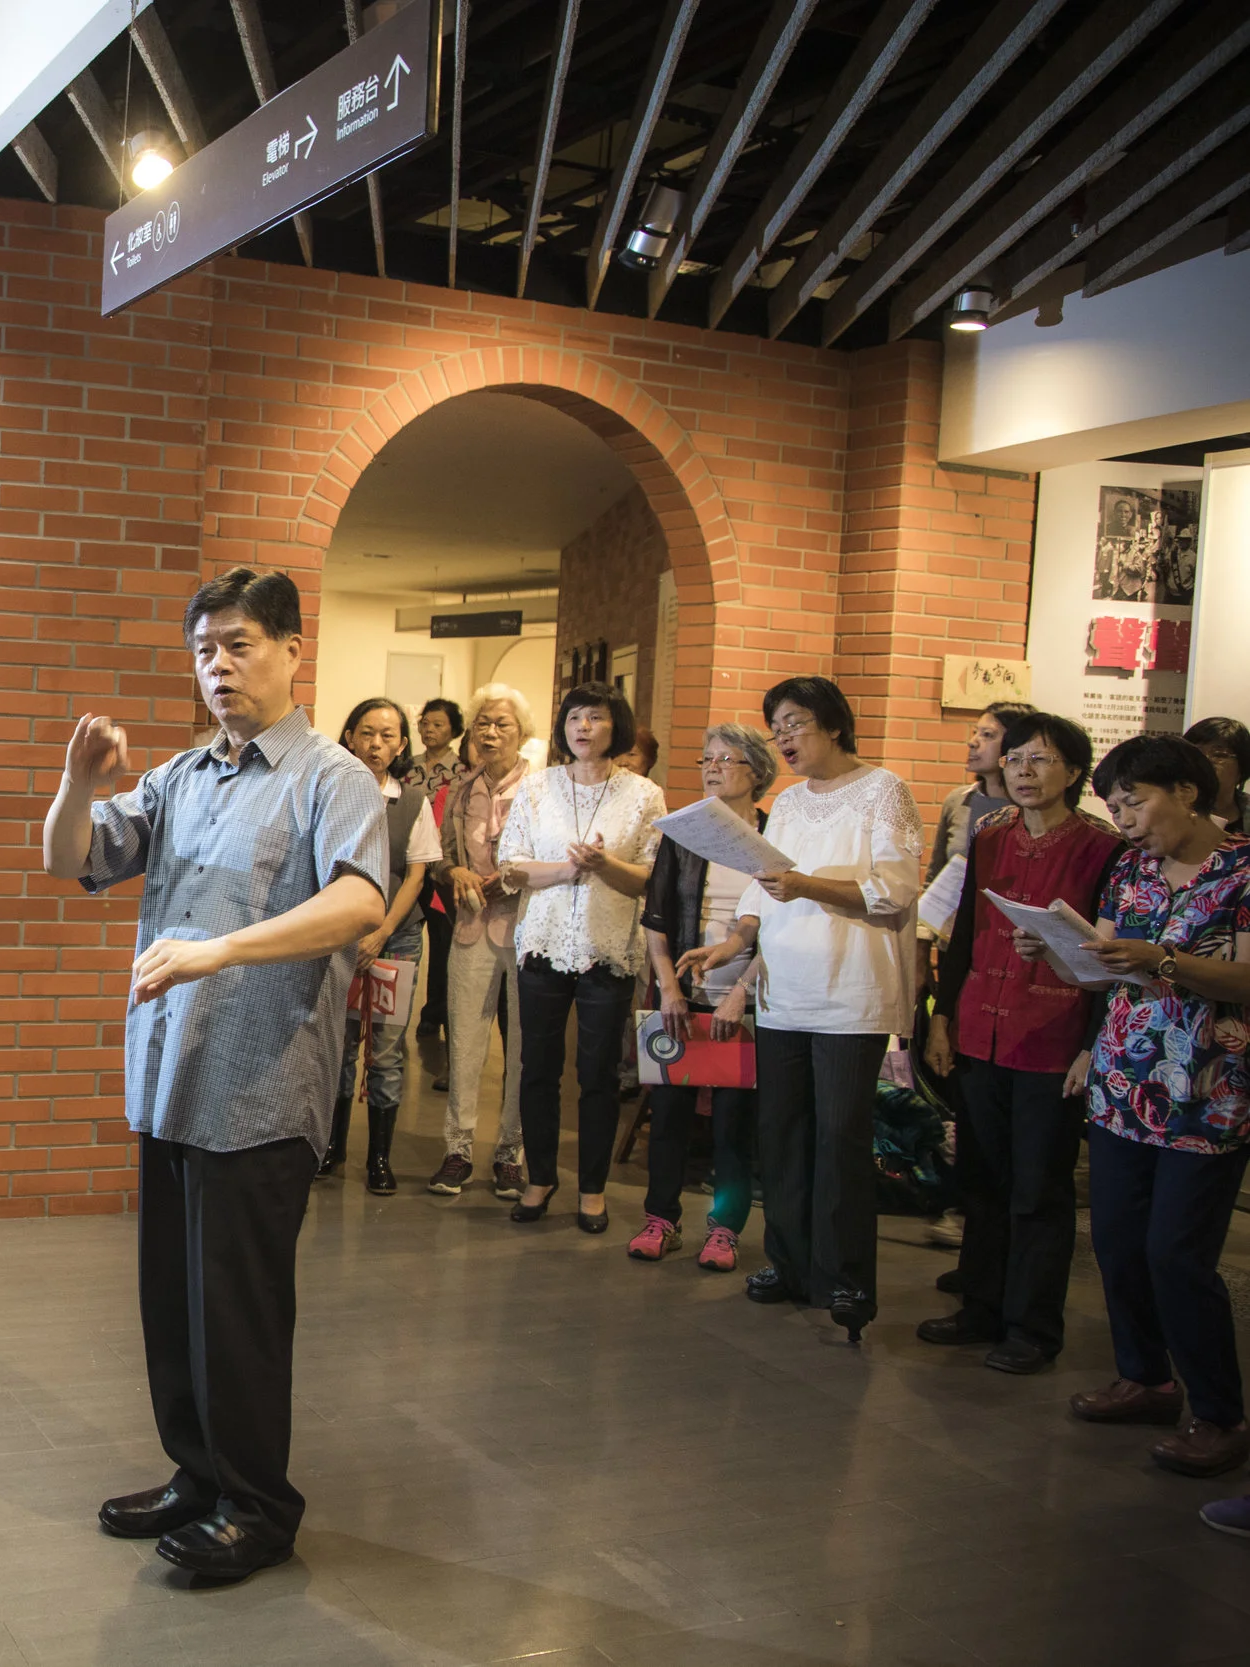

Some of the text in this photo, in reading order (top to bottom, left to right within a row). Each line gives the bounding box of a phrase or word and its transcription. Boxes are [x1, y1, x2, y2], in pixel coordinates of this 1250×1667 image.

[337, 74, 380, 121] 服務台
[336, 107, 379, 141] Information
[266, 130, 290, 164] 電梯
[262, 162, 290, 187] Elevator
[126, 252, 142, 269] Toilets
